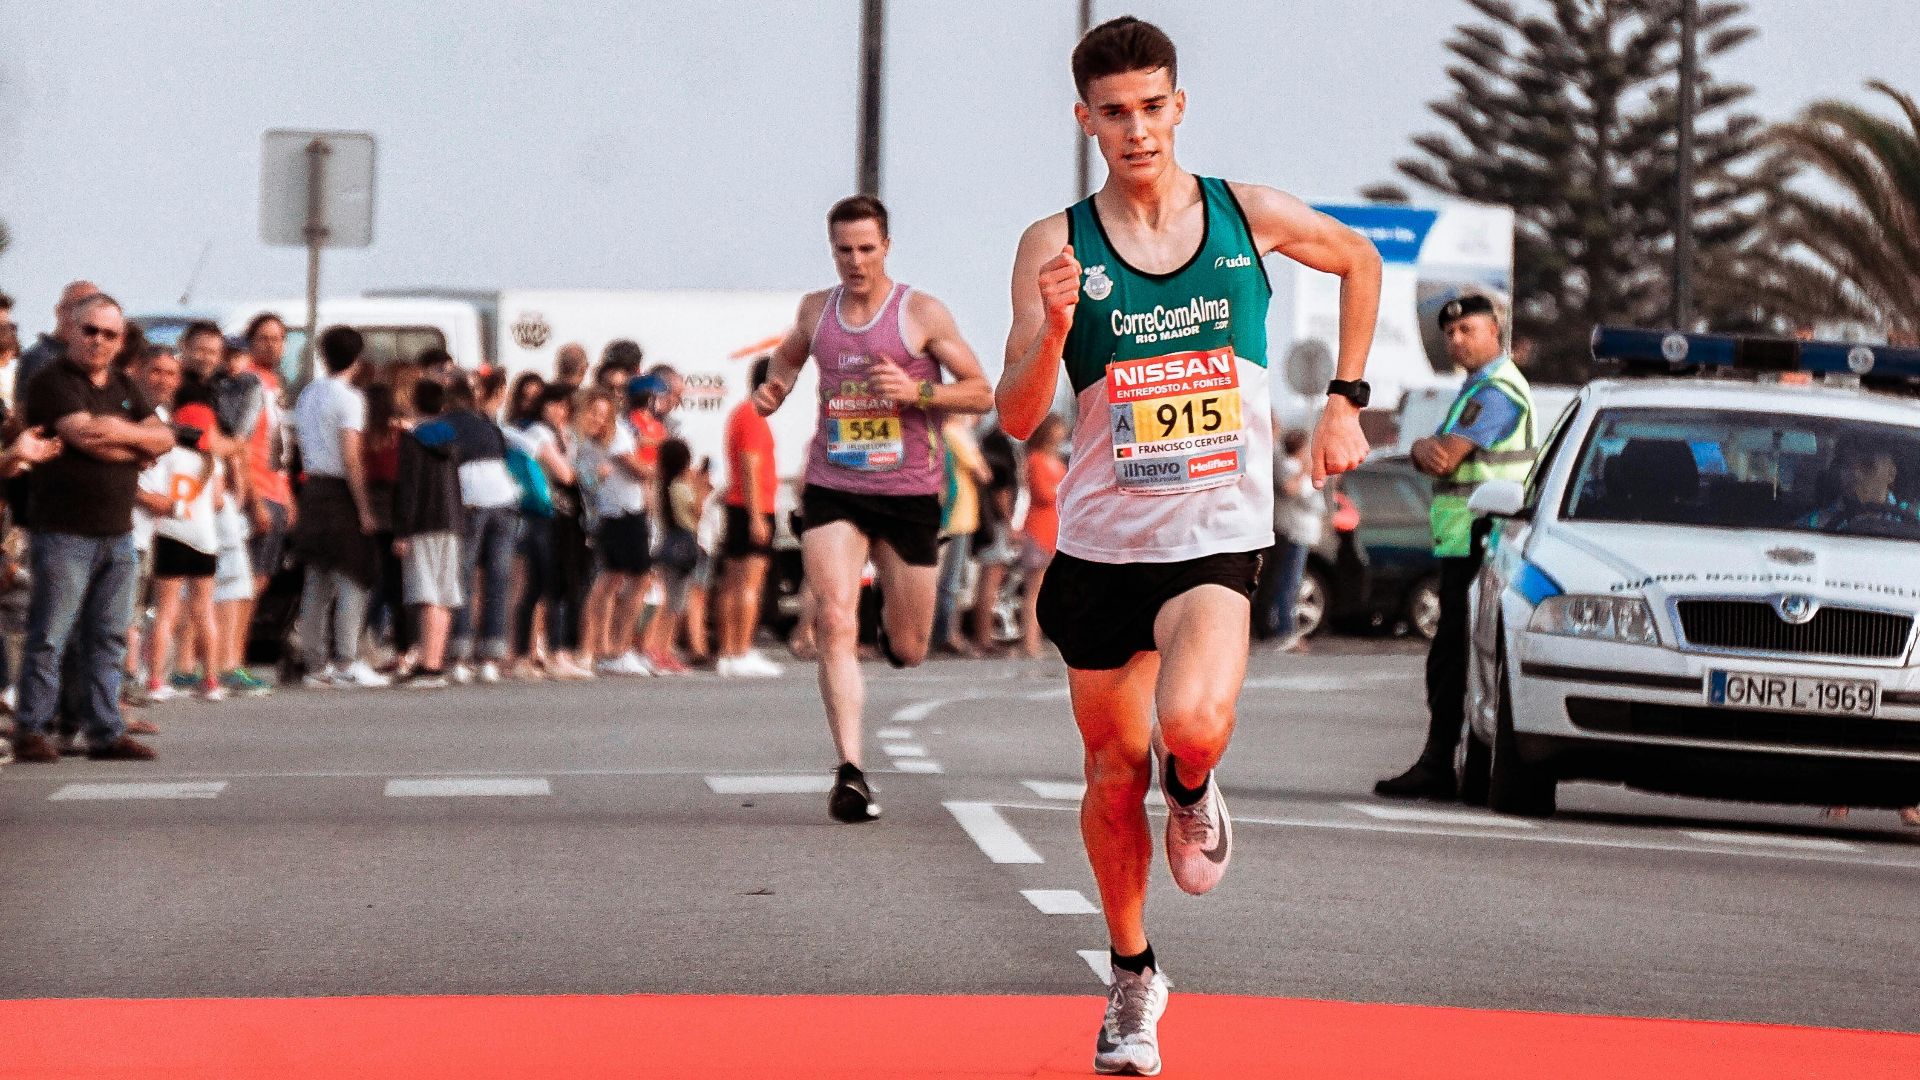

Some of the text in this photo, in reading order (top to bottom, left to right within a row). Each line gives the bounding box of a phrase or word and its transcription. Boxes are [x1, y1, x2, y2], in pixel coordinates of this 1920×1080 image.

[1111, 296, 1230, 336] CorreComAlma
[1135, 325, 1200, 344] RIO MAIOR
[1114, 353, 1231, 387] NISSAN
[1116, 382, 1181, 399] ENTREPOSTO
[1193, 376, 1232, 390] FONTES
[829, 399, 894, 411] NISSAN
[1115, 414, 1131, 433] A
[1156, 397, 1222, 437] 915
[850, 420, 890, 440] 554
[1138, 434, 1239, 454] FRANCISCO CERVEIRA
[1190, 458, 1236, 473] Heliflex
[1610, 574, 1697, 592] GUARDA
[1706, 573, 1812, 584] NACIONAL
